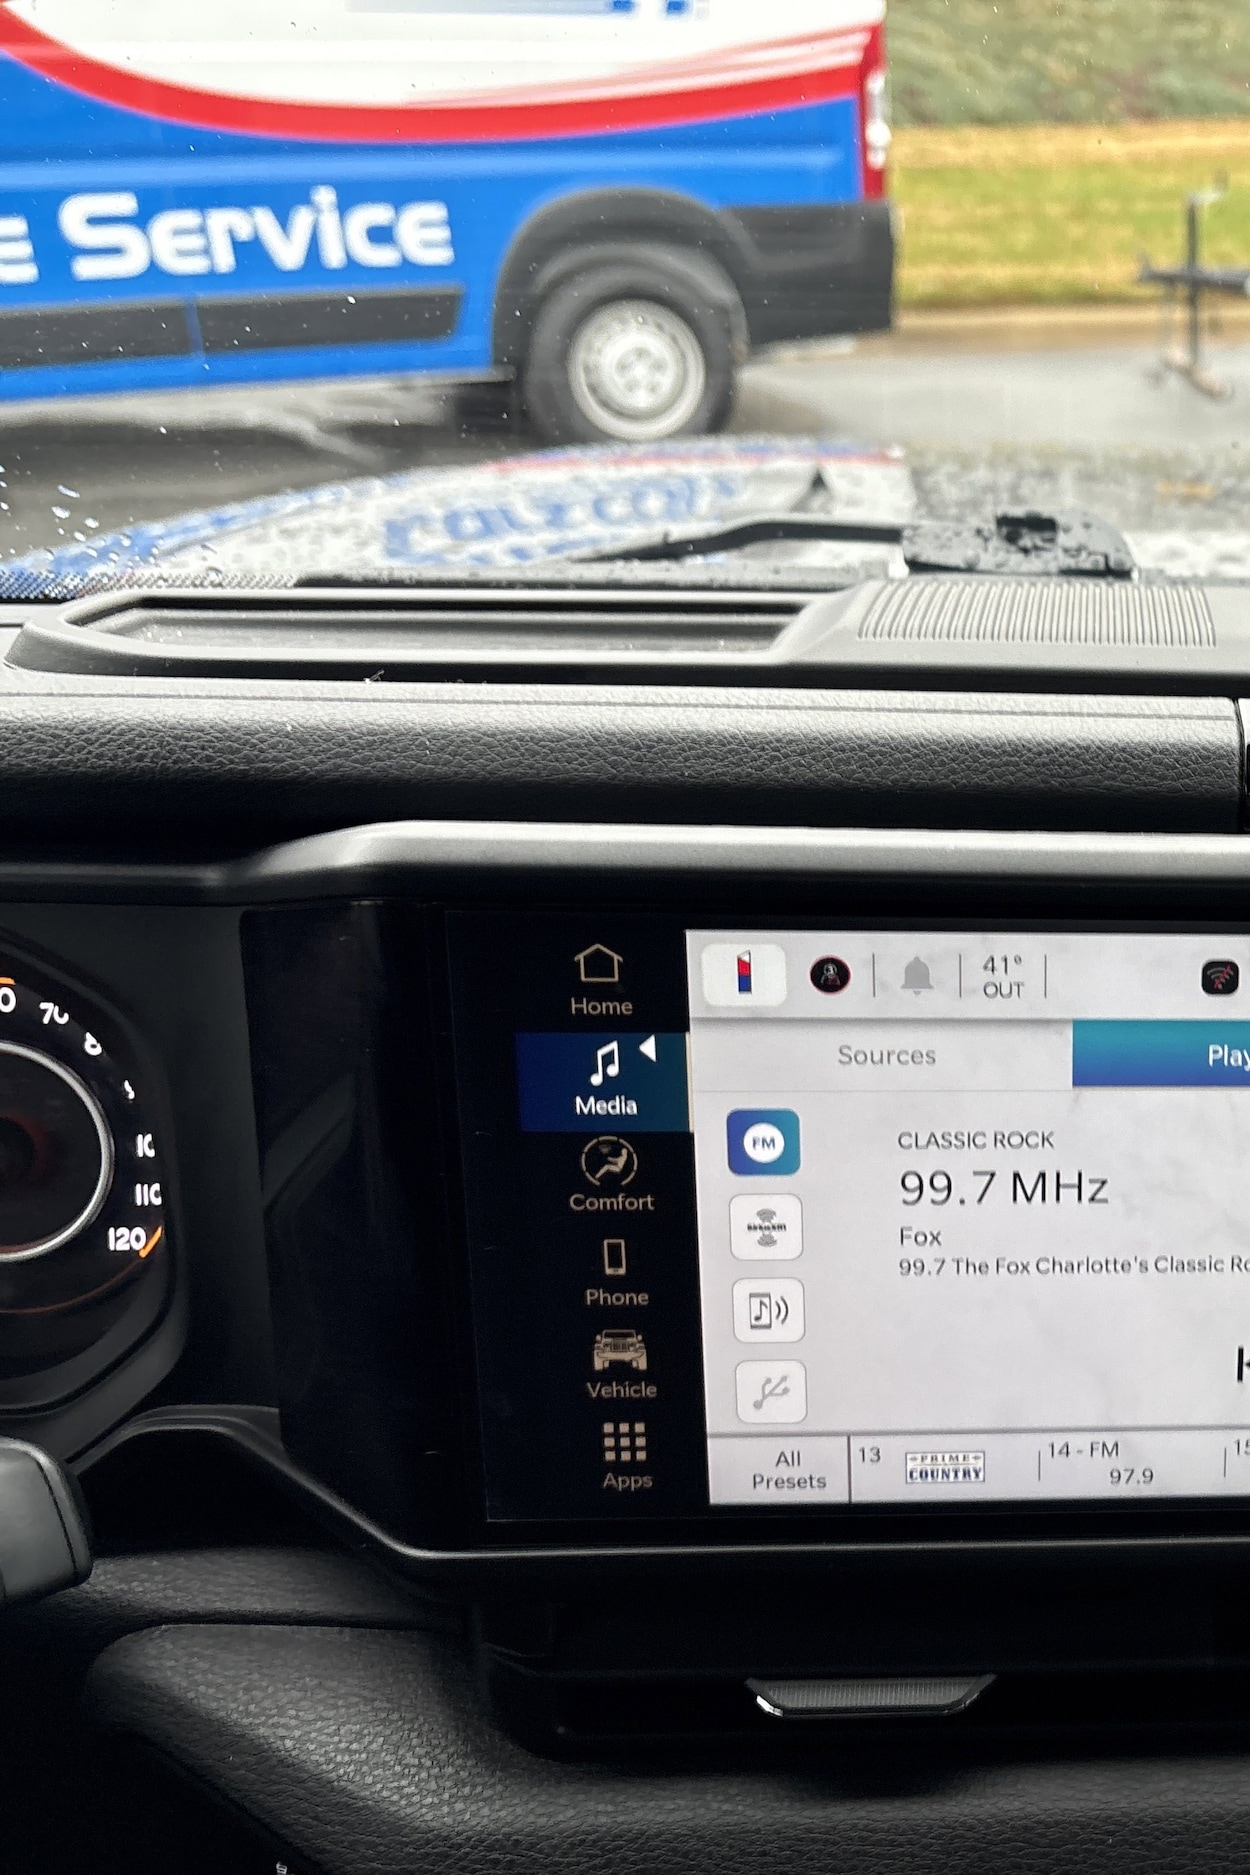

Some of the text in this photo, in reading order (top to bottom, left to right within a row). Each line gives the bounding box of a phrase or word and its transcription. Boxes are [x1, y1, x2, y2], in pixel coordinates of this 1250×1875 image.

[57, 183, 456, 282] Service
[982, 953, 1023, 976] 41°
[982, 980, 1024, 1000] OUT
[570, 997, 634, 1017] Home
[837, 1043, 938, 1068] Sources
[574, 1093, 639, 1117] Media
[751, 1134, 776, 1152] FM
[897, 1130, 1056, 1151] CLASSIC ROCK
[899, 1169, 1109, 1207] 99.7 MHz
[569, 1192, 656, 1212] Comfort
[108, 1226, 146, 1251] 120
[900, 1226, 943, 1247] Fox
[899, 1257, 947, 1277] 99.7
[952, 1256, 990, 1276] The
[995, 1256, 1031, 1276] Fox
[1035, 1254, 1150, 1276] Charlotte's
[1154, 1254, 1225, 1274] Classic
[585, 1288, 650, 1307] Phone
[585, 1379, 659, 1400] Vehicle
[774, 1449, 802, 1468] All
[859, 1445, 882, 1464] 13
[919, 1454, 971, 1463] PRIME
[1048, 1441, 1071, 1459] 14
[1088, 1440, 1121, 1459] FM
[602, 1470, 655, 1493] Apps
[752, 1472, 829, 1491] Presets
[908, 1467, 983, 1481] COUNTRY
[1108, 1466, 1155, 1486] 97.9
